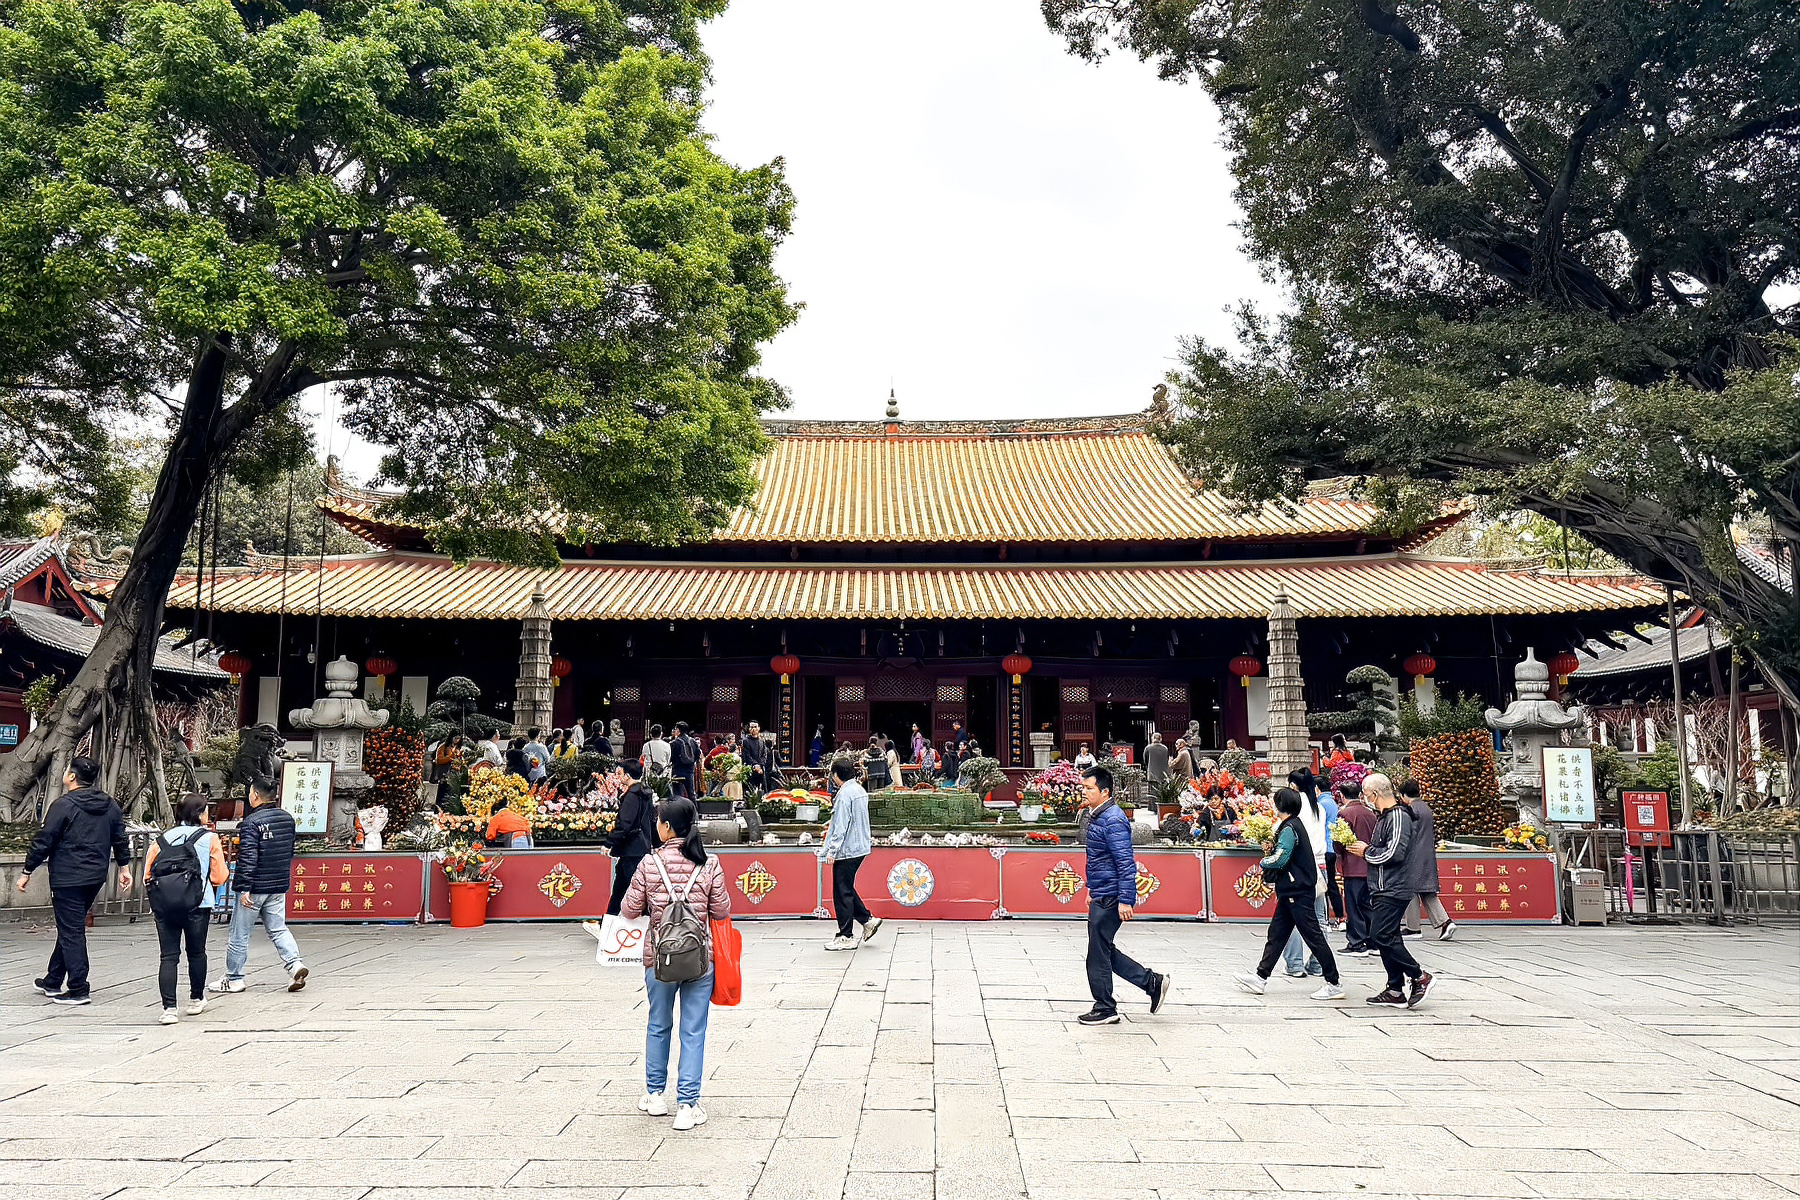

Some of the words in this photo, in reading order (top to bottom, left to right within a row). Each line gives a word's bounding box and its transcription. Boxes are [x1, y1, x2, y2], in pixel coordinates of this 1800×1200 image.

[295, 863, 375, 875] 合十问讯
[1451, 863, 1509, 875] 十问讯
[542, 872, 575, 898] 花
[738, 871, 774, 895] 佛
[1045, 869, 1078, 895] 请
[1454, 881, 1511, 893] 勿跪地
[293, 898, 374, 911] 鲜花供养
[1454, 898, 1511, 911] 花供养
